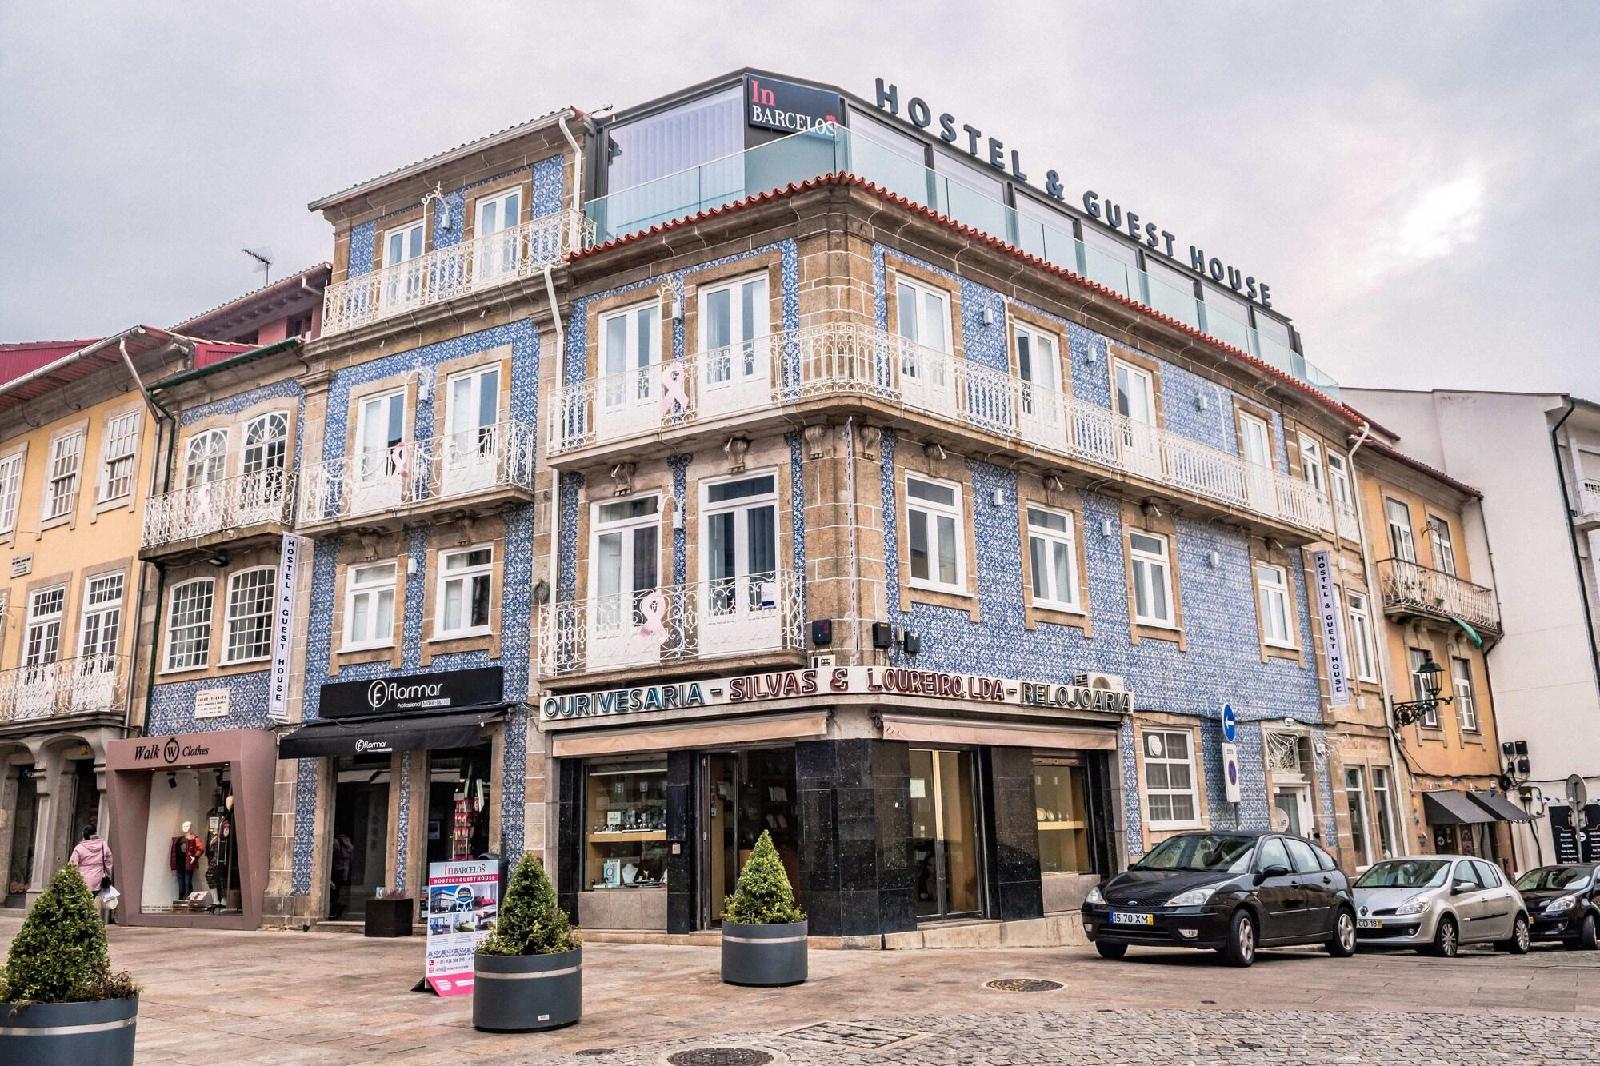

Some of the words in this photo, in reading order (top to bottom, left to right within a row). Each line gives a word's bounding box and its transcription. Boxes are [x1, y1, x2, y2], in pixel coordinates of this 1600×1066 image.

[752, 80, 775, 107] In
[752, 105, 835, 136] BARCELOS
[875, 77, 1027, 181] HOSTEL
[1046, 169, 1064, 200] &
[1082, 190, 1175, 257] GUEST
[1189, 245, 1272, 308] HOUSE
[285, 541, 295, 588] HOSTEL
[280, 609, 289, 650] GUEST
[1317, 556, 1328, 597] HOSTEL
[1325, 615, 1337, 650] GUEST
[1331, 656, 1343, 693] HOUSE
[275, 658, 284, 701] HOUSE
[388, 683, 443, 700] flormar
[544, 682, 705, 719] OURIVESARIA
[729, 670, 818, 701] SILVAS
[830, 668, 848, 692] &
[1020, 682, 1133, 713] RELOJOARIA
[134, 744, 161, 761] Walk
[182, 745, 210, 757] Clothes
[363, 741, 387, 749] flormar
